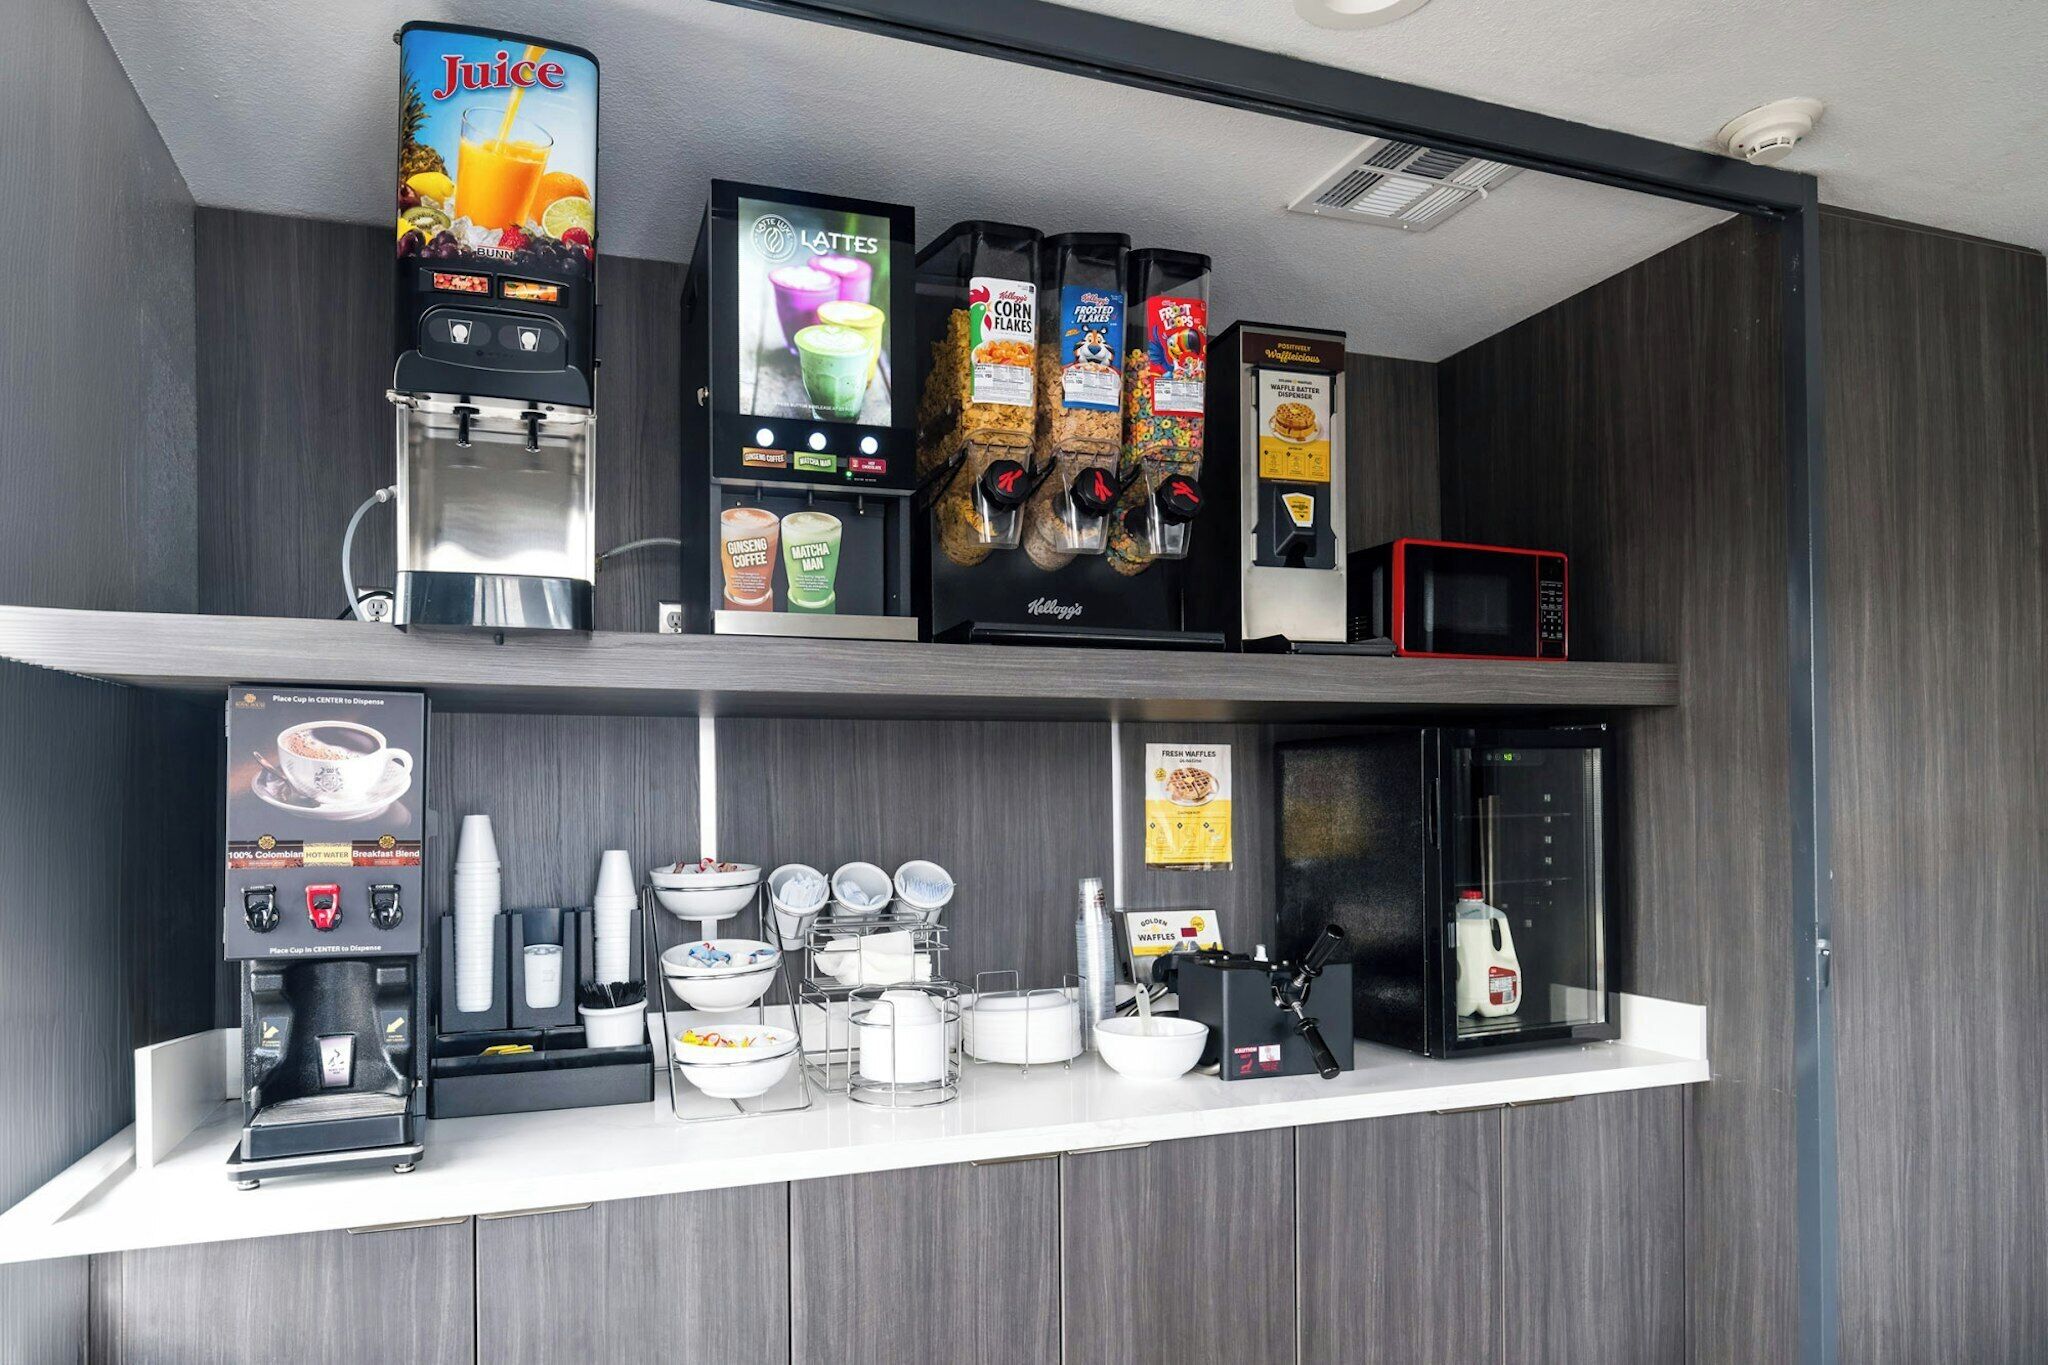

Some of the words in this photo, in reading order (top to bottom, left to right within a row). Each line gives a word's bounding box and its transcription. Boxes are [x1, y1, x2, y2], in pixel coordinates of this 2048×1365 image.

[432, 50, 564, 100] Juice
[801, 229, 878, 256] LATTES
[477, 247, 514, 260] BUNN
[994, 300, 1032, 320] CORN
[1074, 305, 1114, 315] FROSTED
[1158, 303, 1191, 322] FROOT
[1076, 314, 1110, 323] FLAKES
[1163, 315, 1194, 331] LOOPS
[994, 316, 1032, 334] FLAKES
[1277, 342, 1312, 352] POSITIVELY
[1270, 383, 1295, 392] WAFFLE
[1296, 386, 1320, 394] BATTER
[1278, 391, 1312, 400] DISPENSER
[766, 453, 785, 463] COFFEE
[799, 456, 819, 466] MATCHA
[727, 538, 768, 555] GINSENG
[791, 543, 830, 560] MATCHA
[732, 552, 767, 569] COFFEE
[801, 557, 824, 572] MAN
[1028, 597, 1083, 620] Kellogg's
[272, 694, 292, 703] Place
[293, 695, 307, 704] Cup
[316, 696, 344, 704] CENTER
[344, 697, 352, 705] to
[353, 697, 384, 706] Dispense
[1185, 750, 1216, 758] WAFFLES
[228, 851, 253, 859] 100%
[255, 850, 303, 859] Colombian
[352, 849, 393, 858] Breakfast
[396, 849, 420, 858] Blend
[1140, 918, 1168, 927] GOLDEN
[1138, 934, 1176, 942] WAFFLES
[289, 947, 304, 955] Cup
[313, 945, 341, 953] CENTER
[350, 944, 382, 952] Dispense
